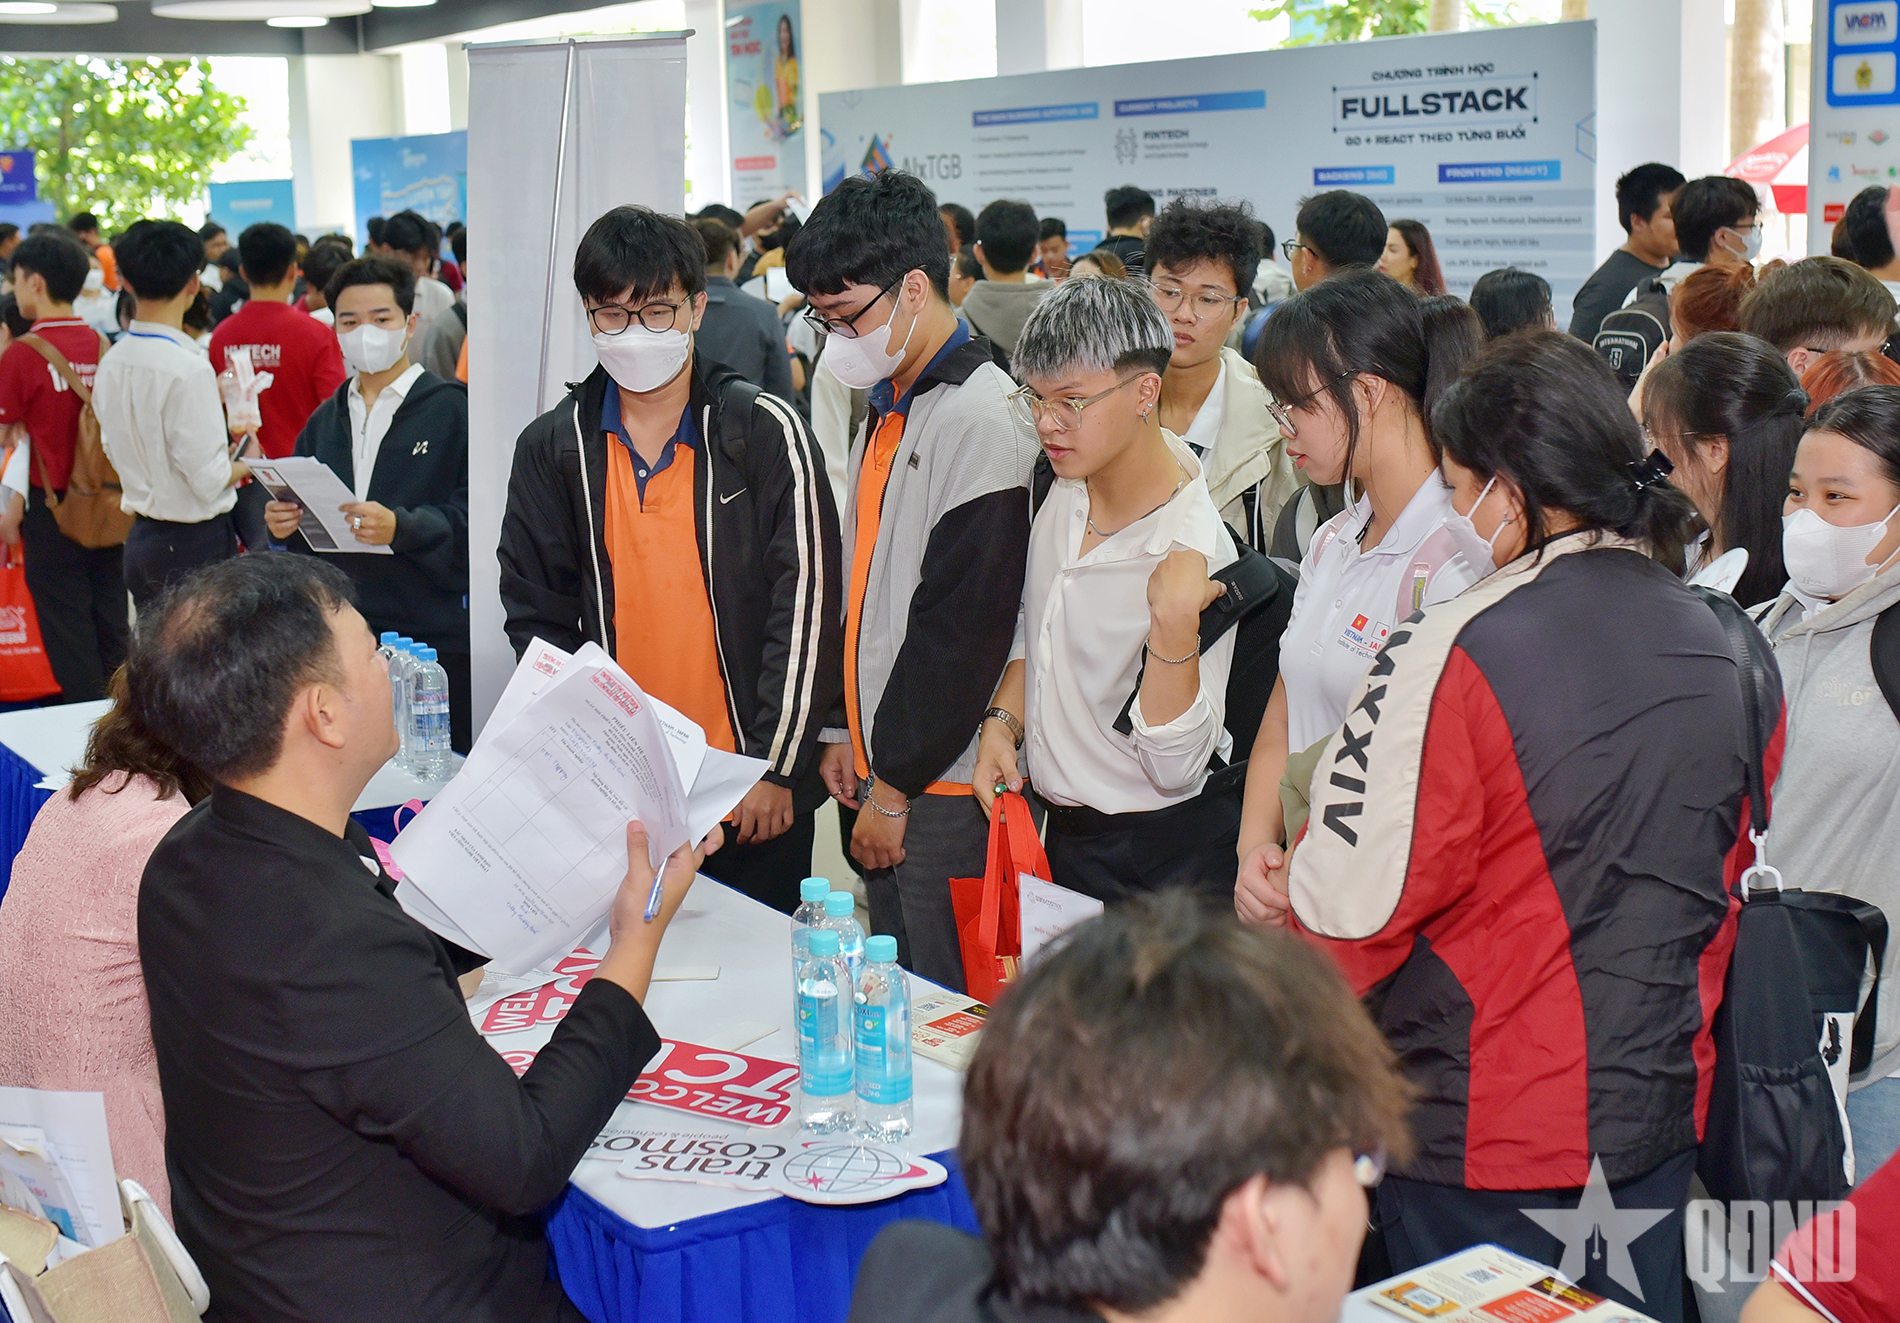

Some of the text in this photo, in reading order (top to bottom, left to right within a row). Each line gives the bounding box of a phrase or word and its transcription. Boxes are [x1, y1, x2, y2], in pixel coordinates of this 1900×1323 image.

[1372, 62, 1494, 81] CHƯƠNG TRÌNH HỌC
[1341, 86, 1529, 119] FULLSTACK
[1143, 129, 1190, 140] FINTECH
[1375, 133, 1414, 146] REACT
[1420, 131, 1453, 143] THEO
[1458, 128, 1493, 142] TỪNG
[1496, 123, 1527, 140] BUỔI
[1318, 170, 1365, 182] BACKEND
[1445, 166, 1503, 178] FRONTEND
[1166, 187, 1218, 197] PARTNER
[1344, 628, 1363, 643] VIETNAM
[681, 1132, 729, 1140] people
[635, 1153, 770, 1181] trans
